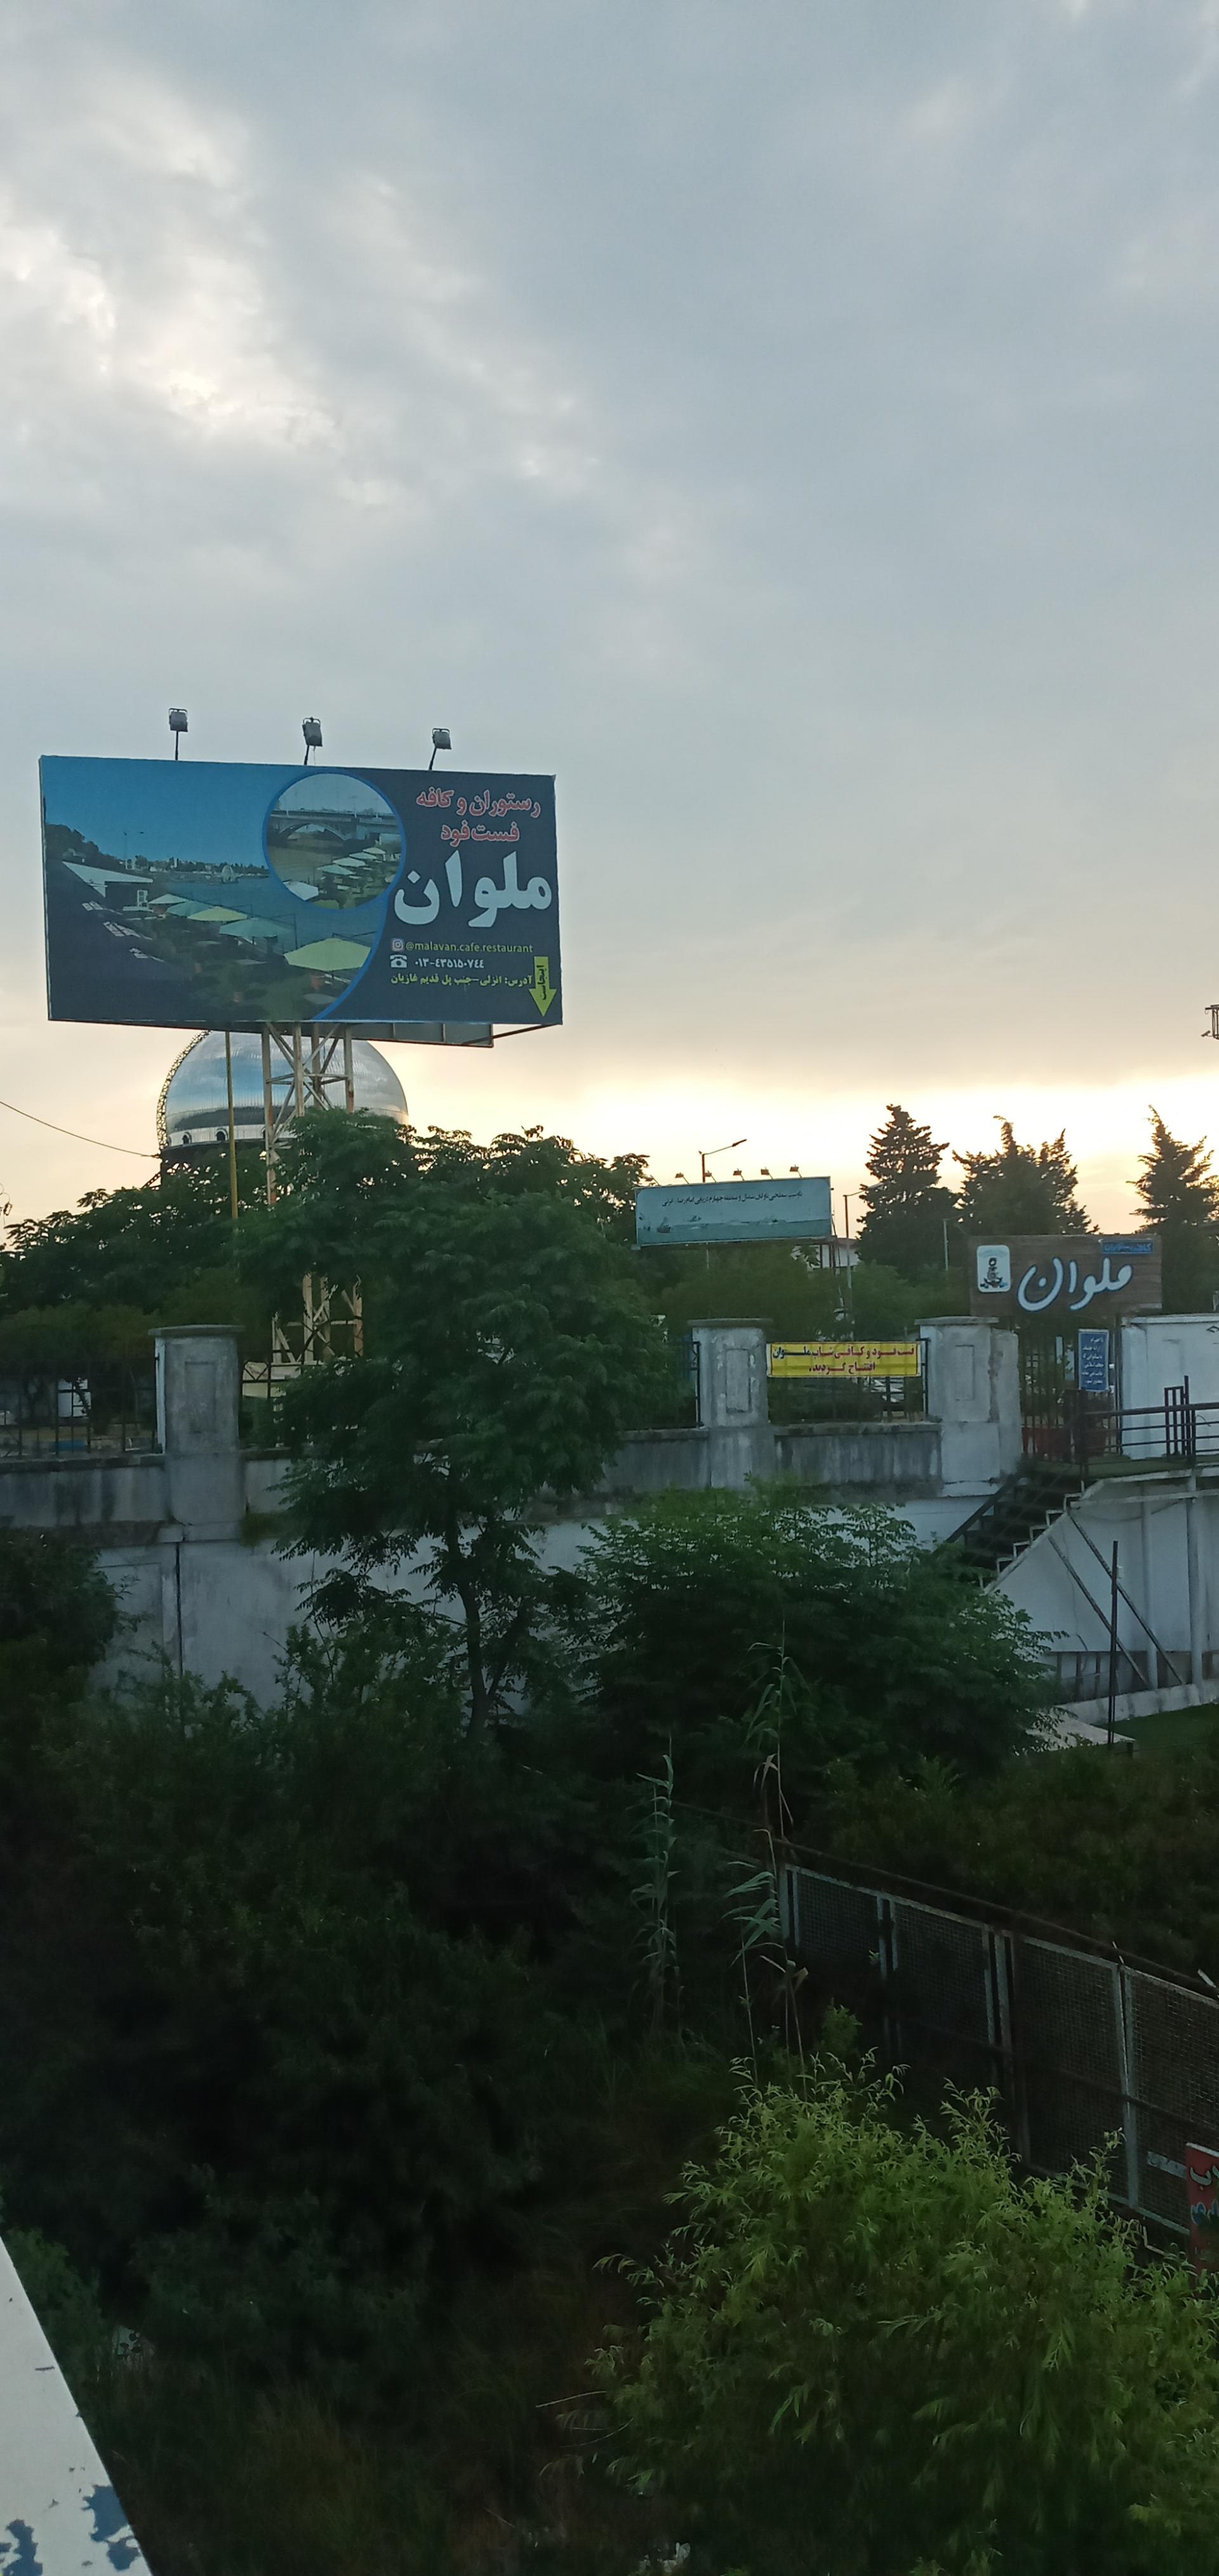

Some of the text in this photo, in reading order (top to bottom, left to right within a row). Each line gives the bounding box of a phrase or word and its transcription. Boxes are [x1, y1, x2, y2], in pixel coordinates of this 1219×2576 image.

[416, 787, 541, 818] رستوران و کافه
[441, 819, 520, 847] فست فود
[394, 849, 552, 928] ملوان
[405, 940, 534, 953] @malavan.cafe.restaurant
[390, 973, 418, 985] غازیان
[420, 973, 440, 985] قدیم
[1017, 1256, 1133, 1312] ملوان
[773, 1346, 811, 1359] ملوان
